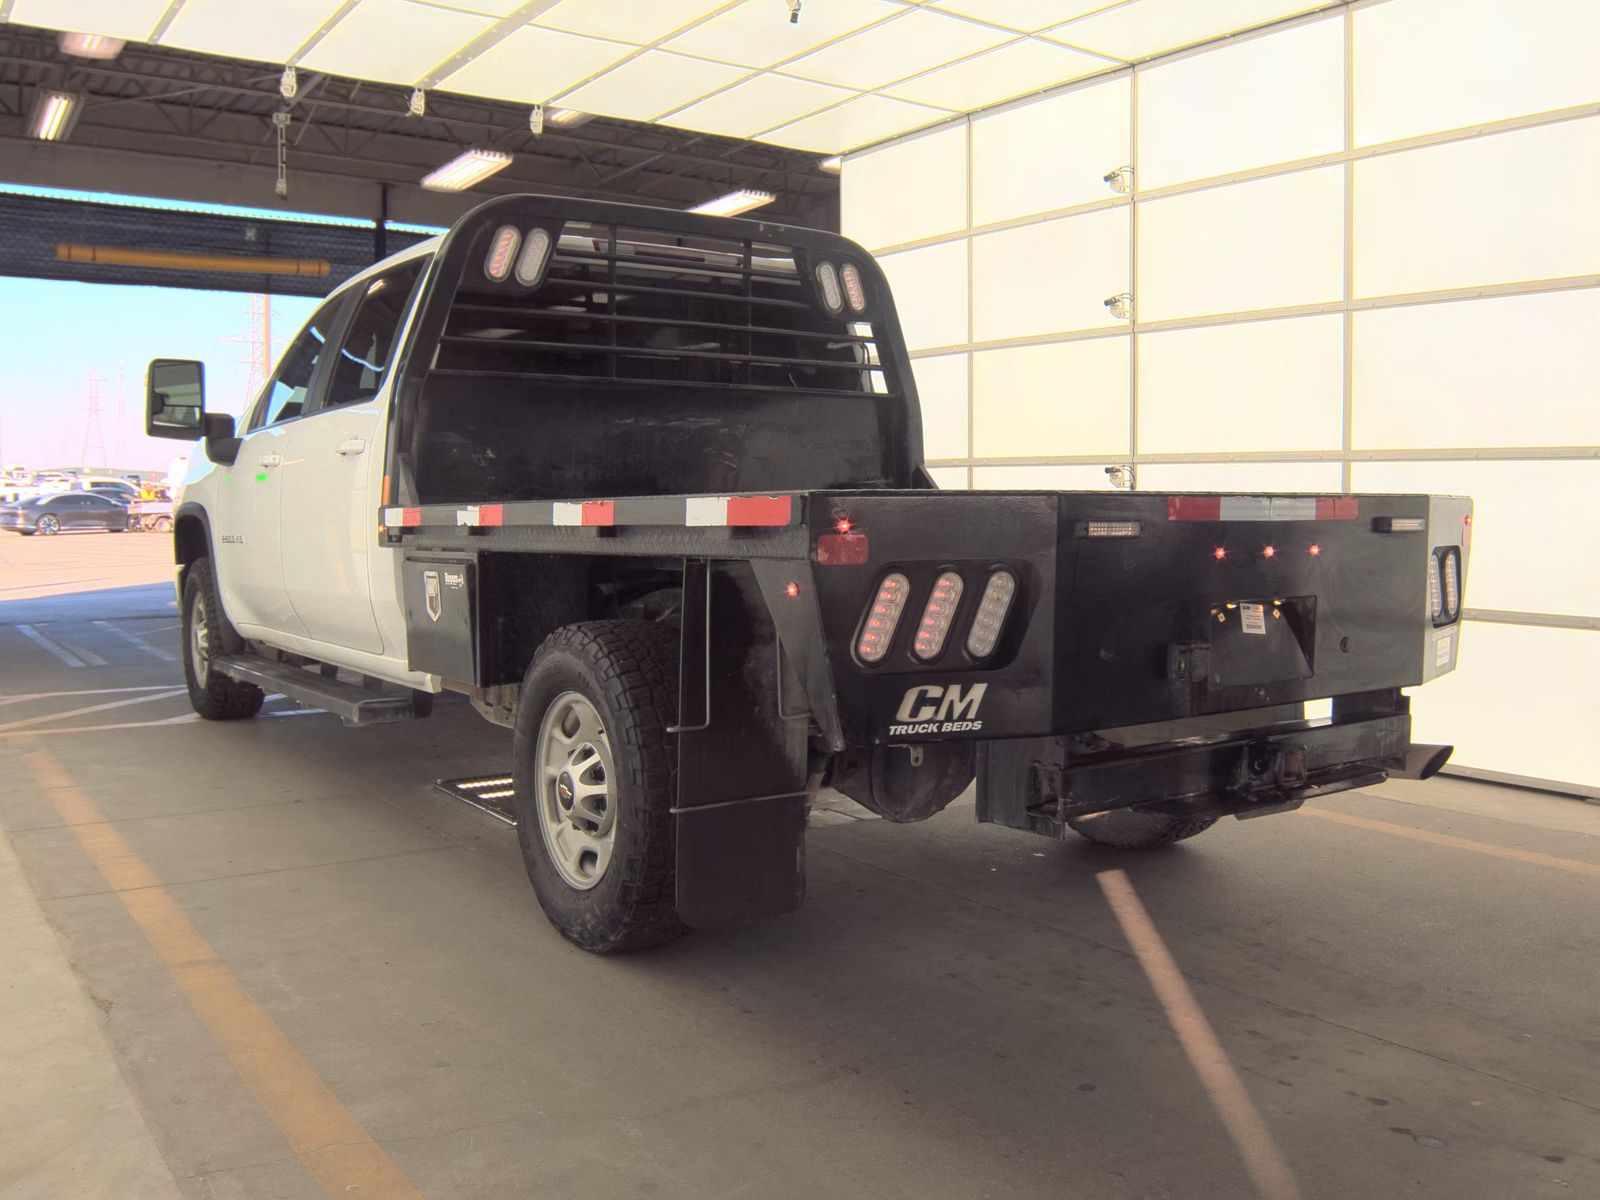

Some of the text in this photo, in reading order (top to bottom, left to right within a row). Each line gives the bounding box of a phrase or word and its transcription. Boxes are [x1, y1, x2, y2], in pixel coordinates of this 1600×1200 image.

[895, 683, 988, 722] CM
[889, 721, 983, 735] TRUCK BEDS
